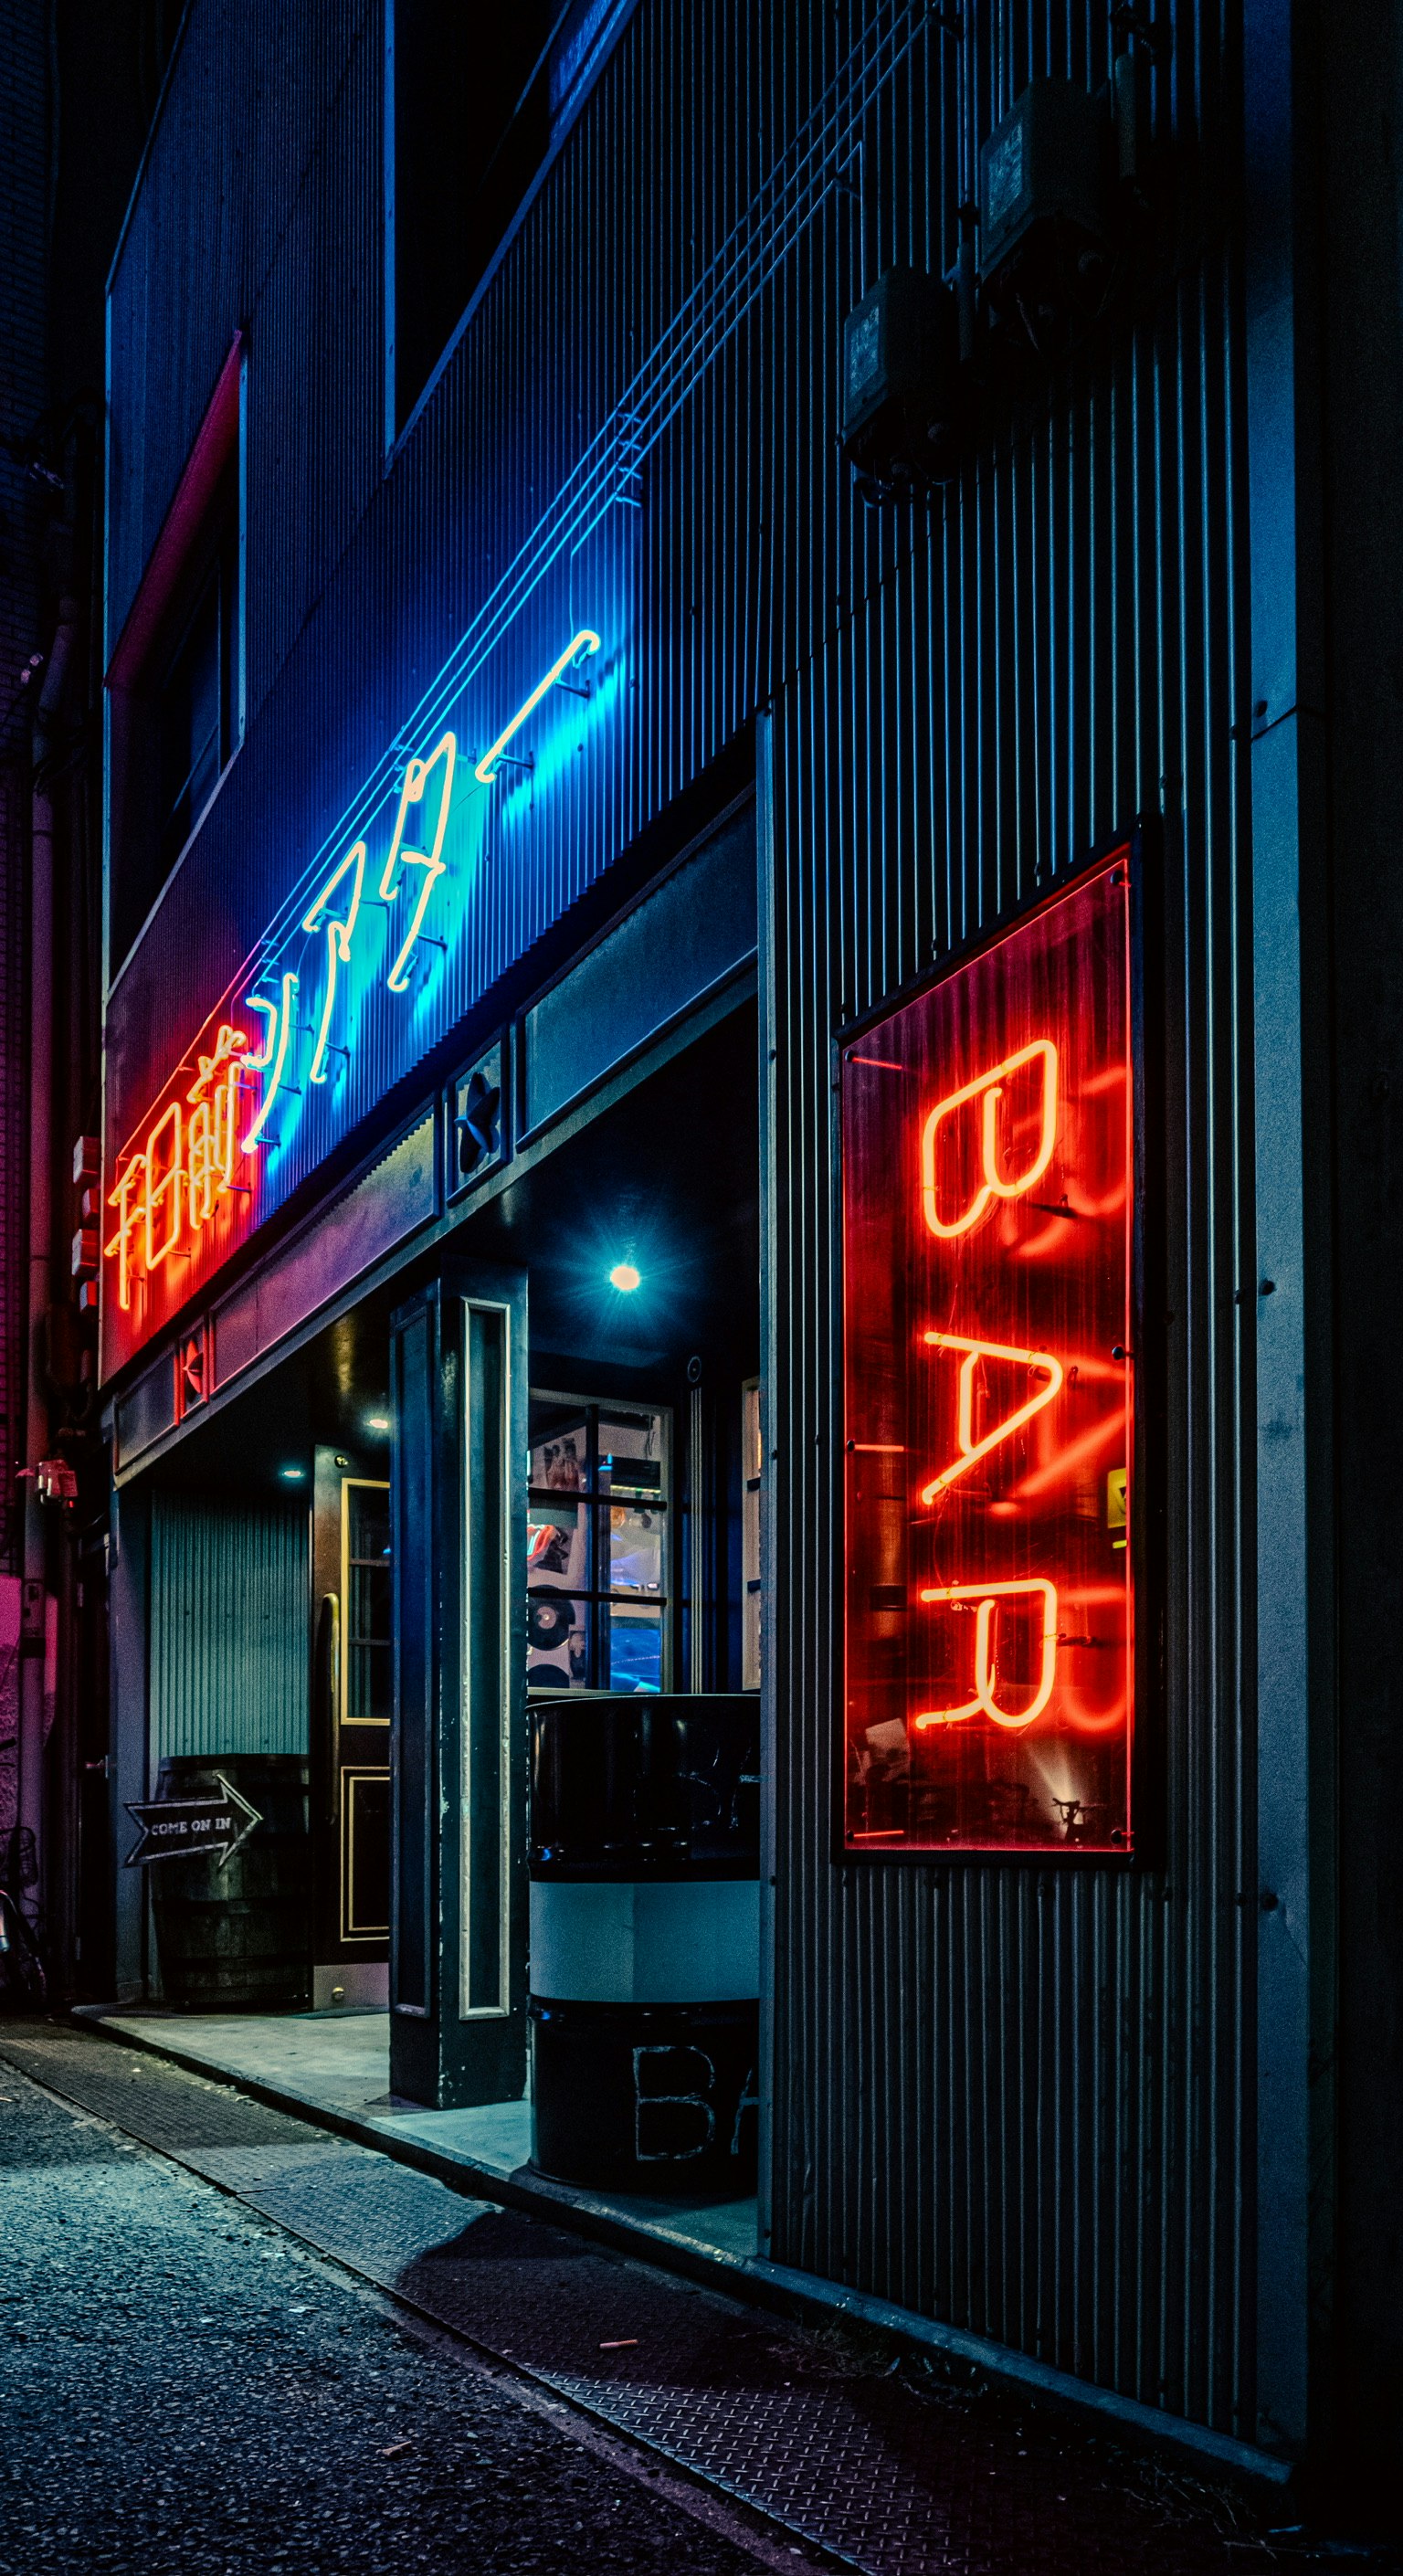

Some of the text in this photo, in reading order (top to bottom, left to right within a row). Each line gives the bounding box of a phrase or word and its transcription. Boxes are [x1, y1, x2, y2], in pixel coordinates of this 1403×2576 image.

[916, 1039, 1061, 1732] BAR
[151, 1817, 232, 1836] COME ON IN
